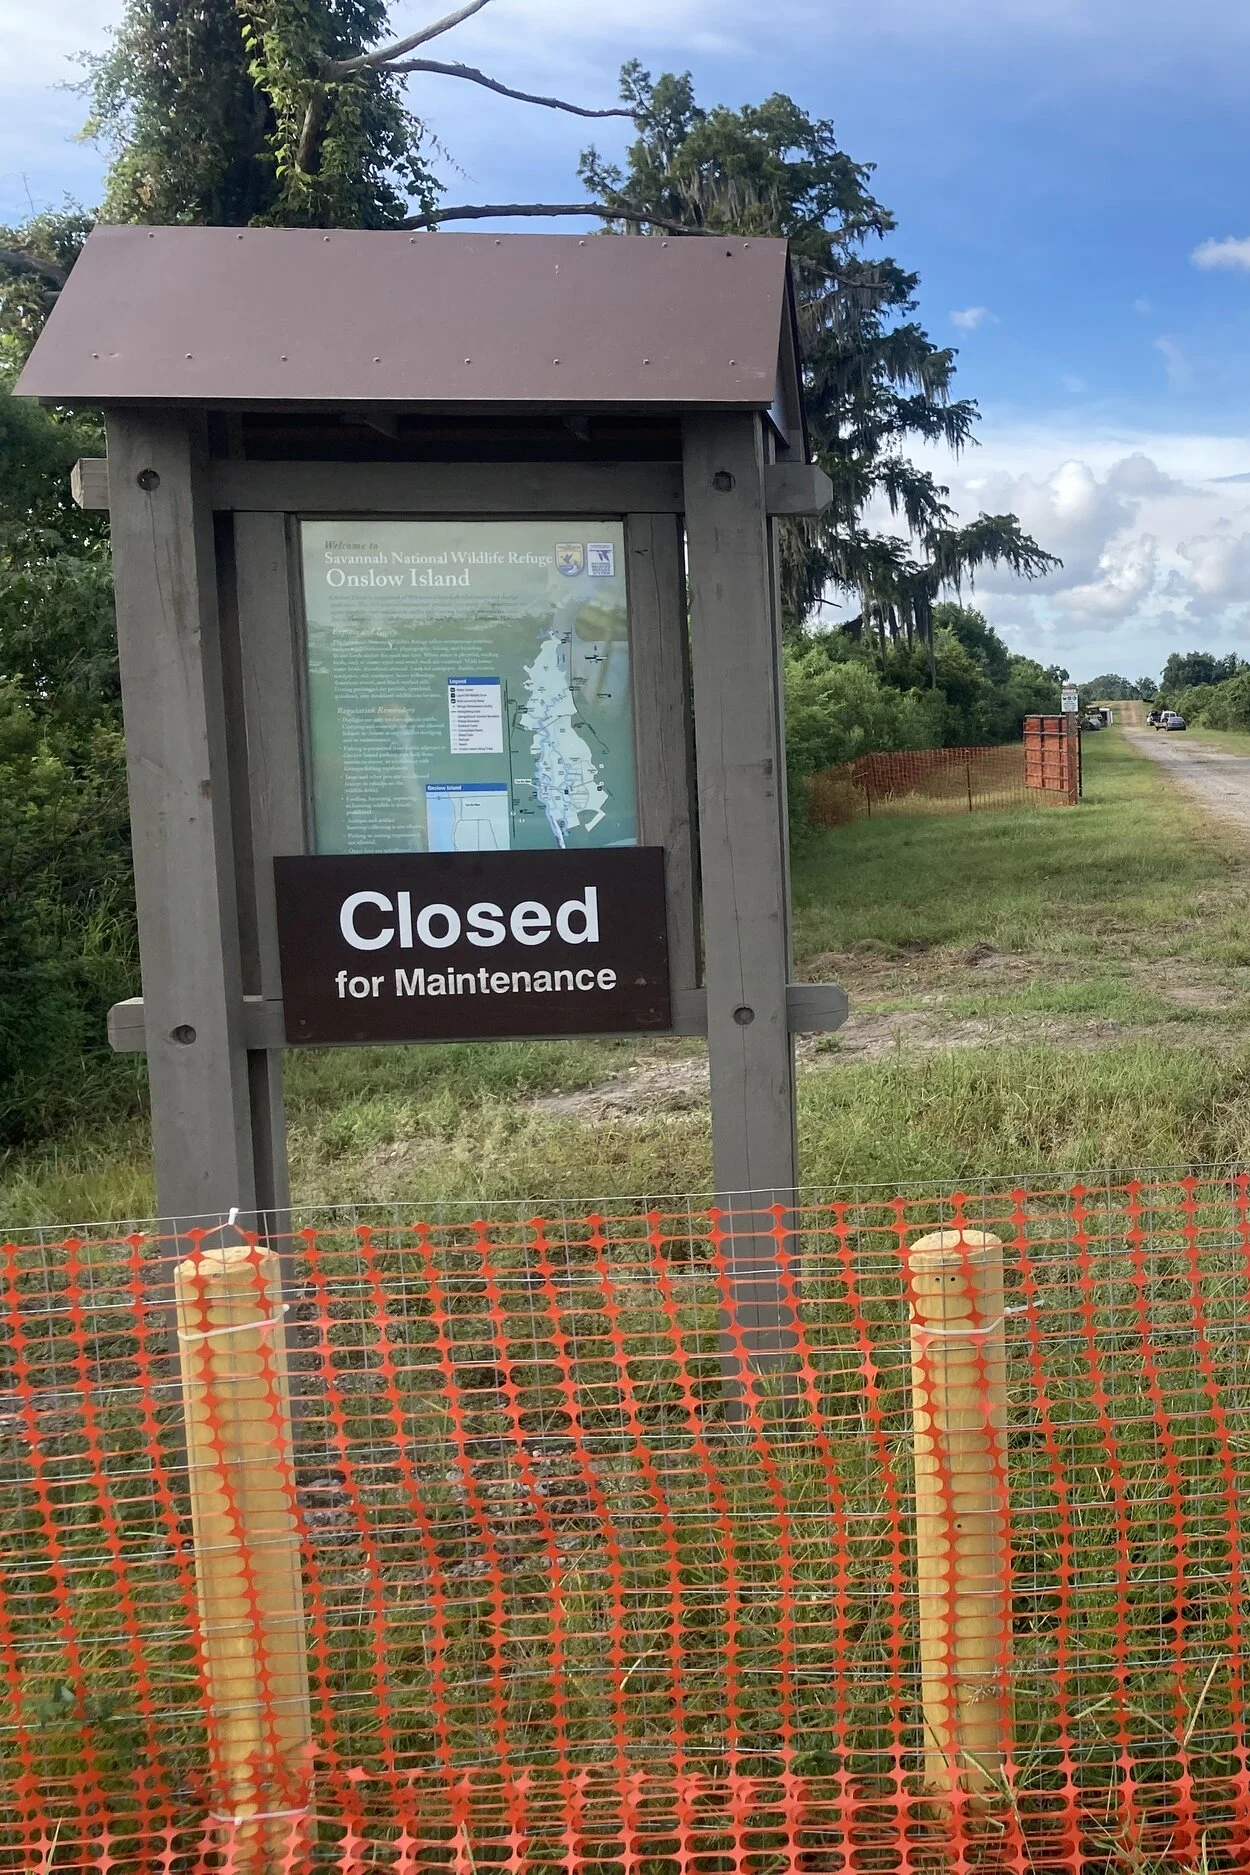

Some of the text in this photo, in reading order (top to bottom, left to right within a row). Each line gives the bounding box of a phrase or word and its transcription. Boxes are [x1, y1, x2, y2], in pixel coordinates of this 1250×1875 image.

[325, 541, 379, 550] Welcome to
[324, 551, 553, 568] Savannah National Wildlife Refuge
[326, 568, 471, 587] Onslow Island
[339, 886, 600, 951] Closed
[335, 966, 618, 998] for Maintenance
